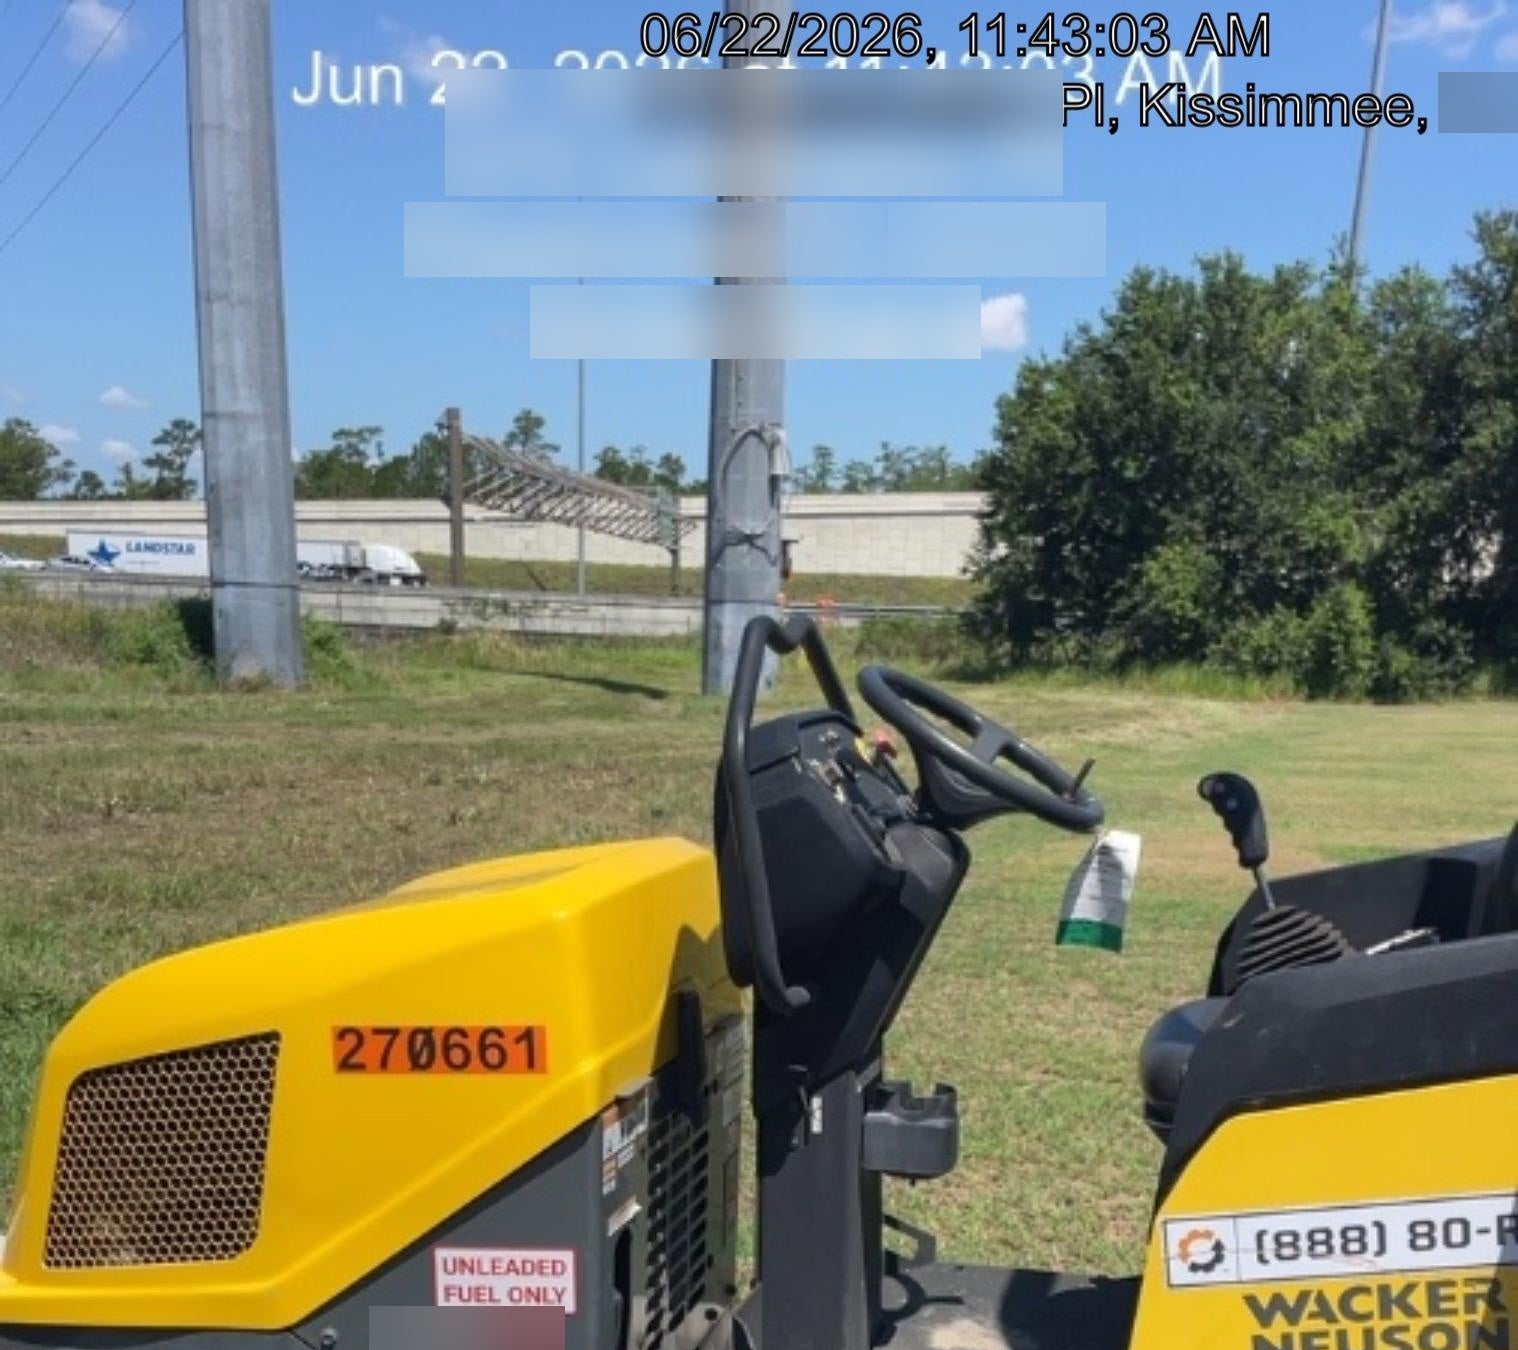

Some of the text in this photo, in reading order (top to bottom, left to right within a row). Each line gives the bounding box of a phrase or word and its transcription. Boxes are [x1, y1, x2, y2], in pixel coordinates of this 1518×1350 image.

[126, 541, 196, 556] LANDSTAR
[337, 1026, 535, 1071] 270661
[1256, 1221, 1387, 1264] (888)
[443, 1257, 567, 1276] UNLEADED
[443, 1284, 566, 1304] FUEL ONLY
[1243, 1277, 1506, 1328] WACKER
